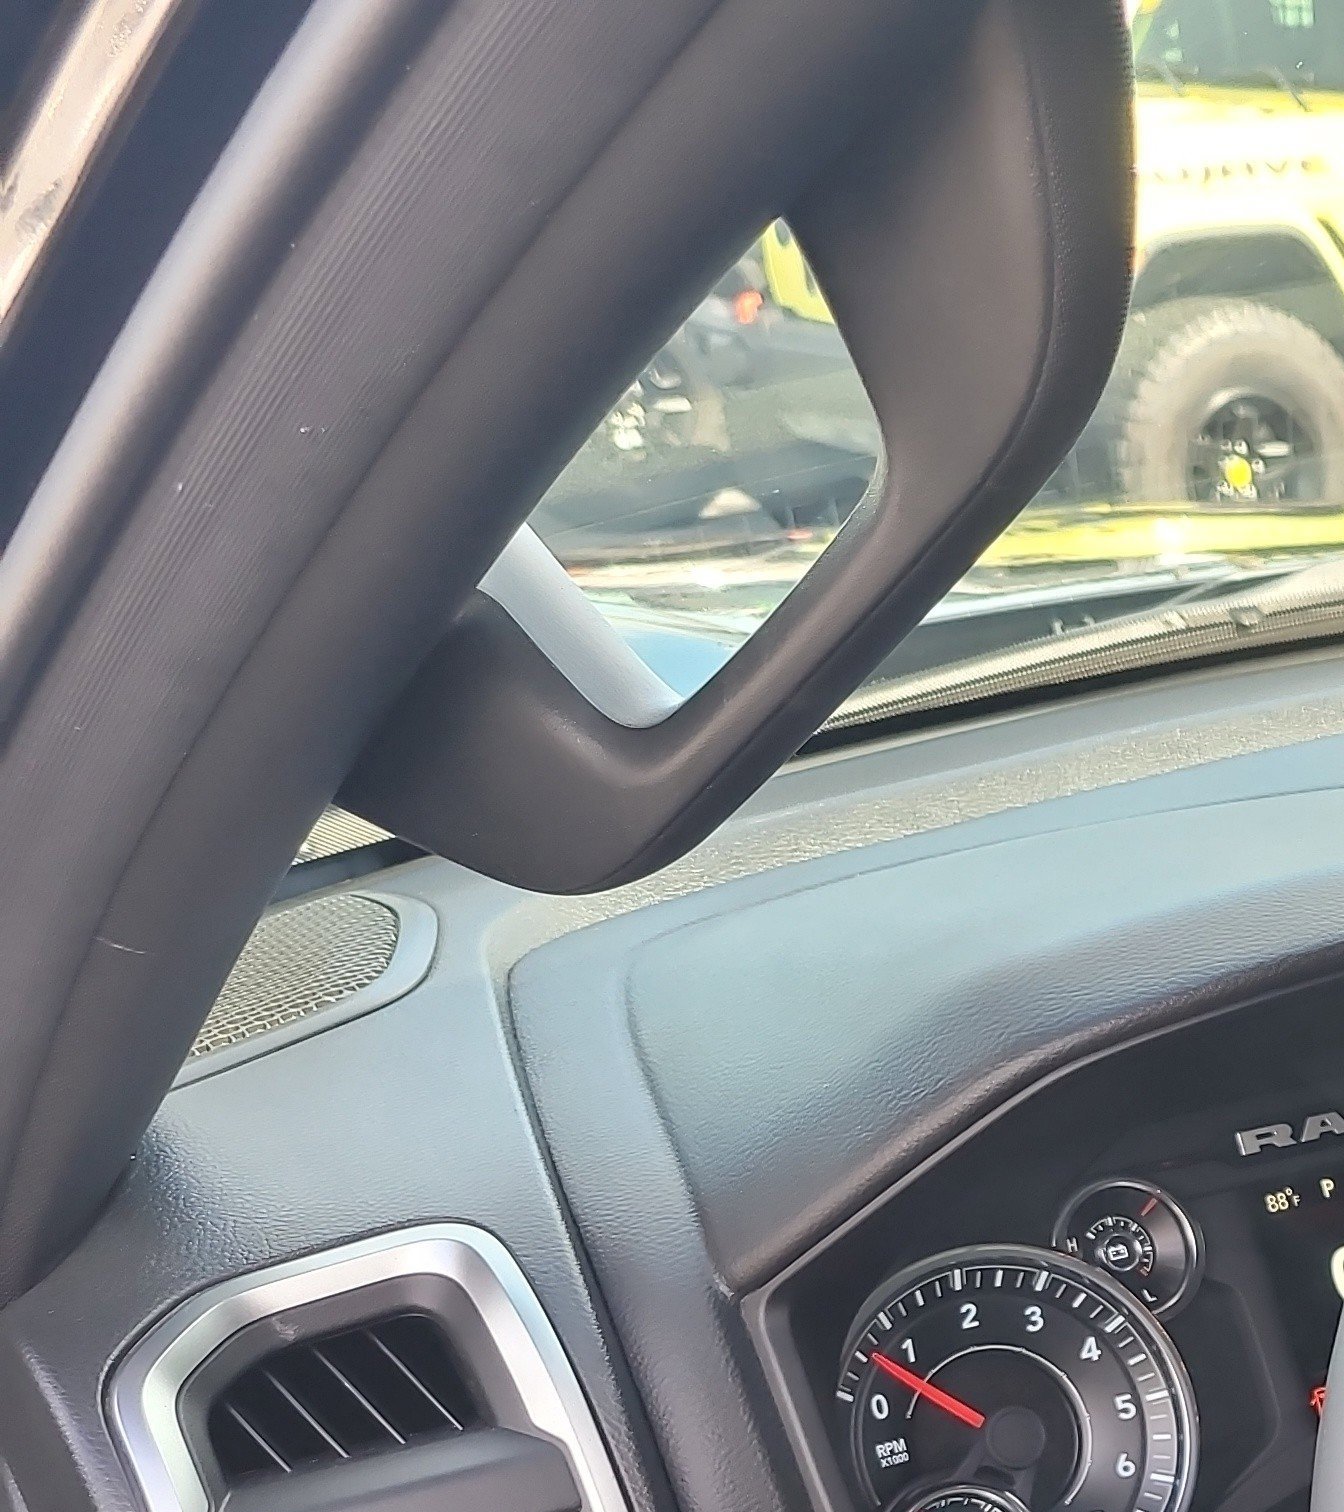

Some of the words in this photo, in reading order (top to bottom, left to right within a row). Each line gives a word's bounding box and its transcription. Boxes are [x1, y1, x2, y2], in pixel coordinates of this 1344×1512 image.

[1066, 1237, 1079, 1253] H
[959, 1303, 980, 1329] 2
[1024, 1306, 1044, 1333] 3
[901, 1338, 916, 1363] 1
[1079, 1336, 1101, 1362] 4
[870, 1394, 890, 1420] 0
[1113, 1393, 1137, 1420] 5
[875, 1438, 908, 1459] RPM
[1115, 1453, 1136, 1478] 6
